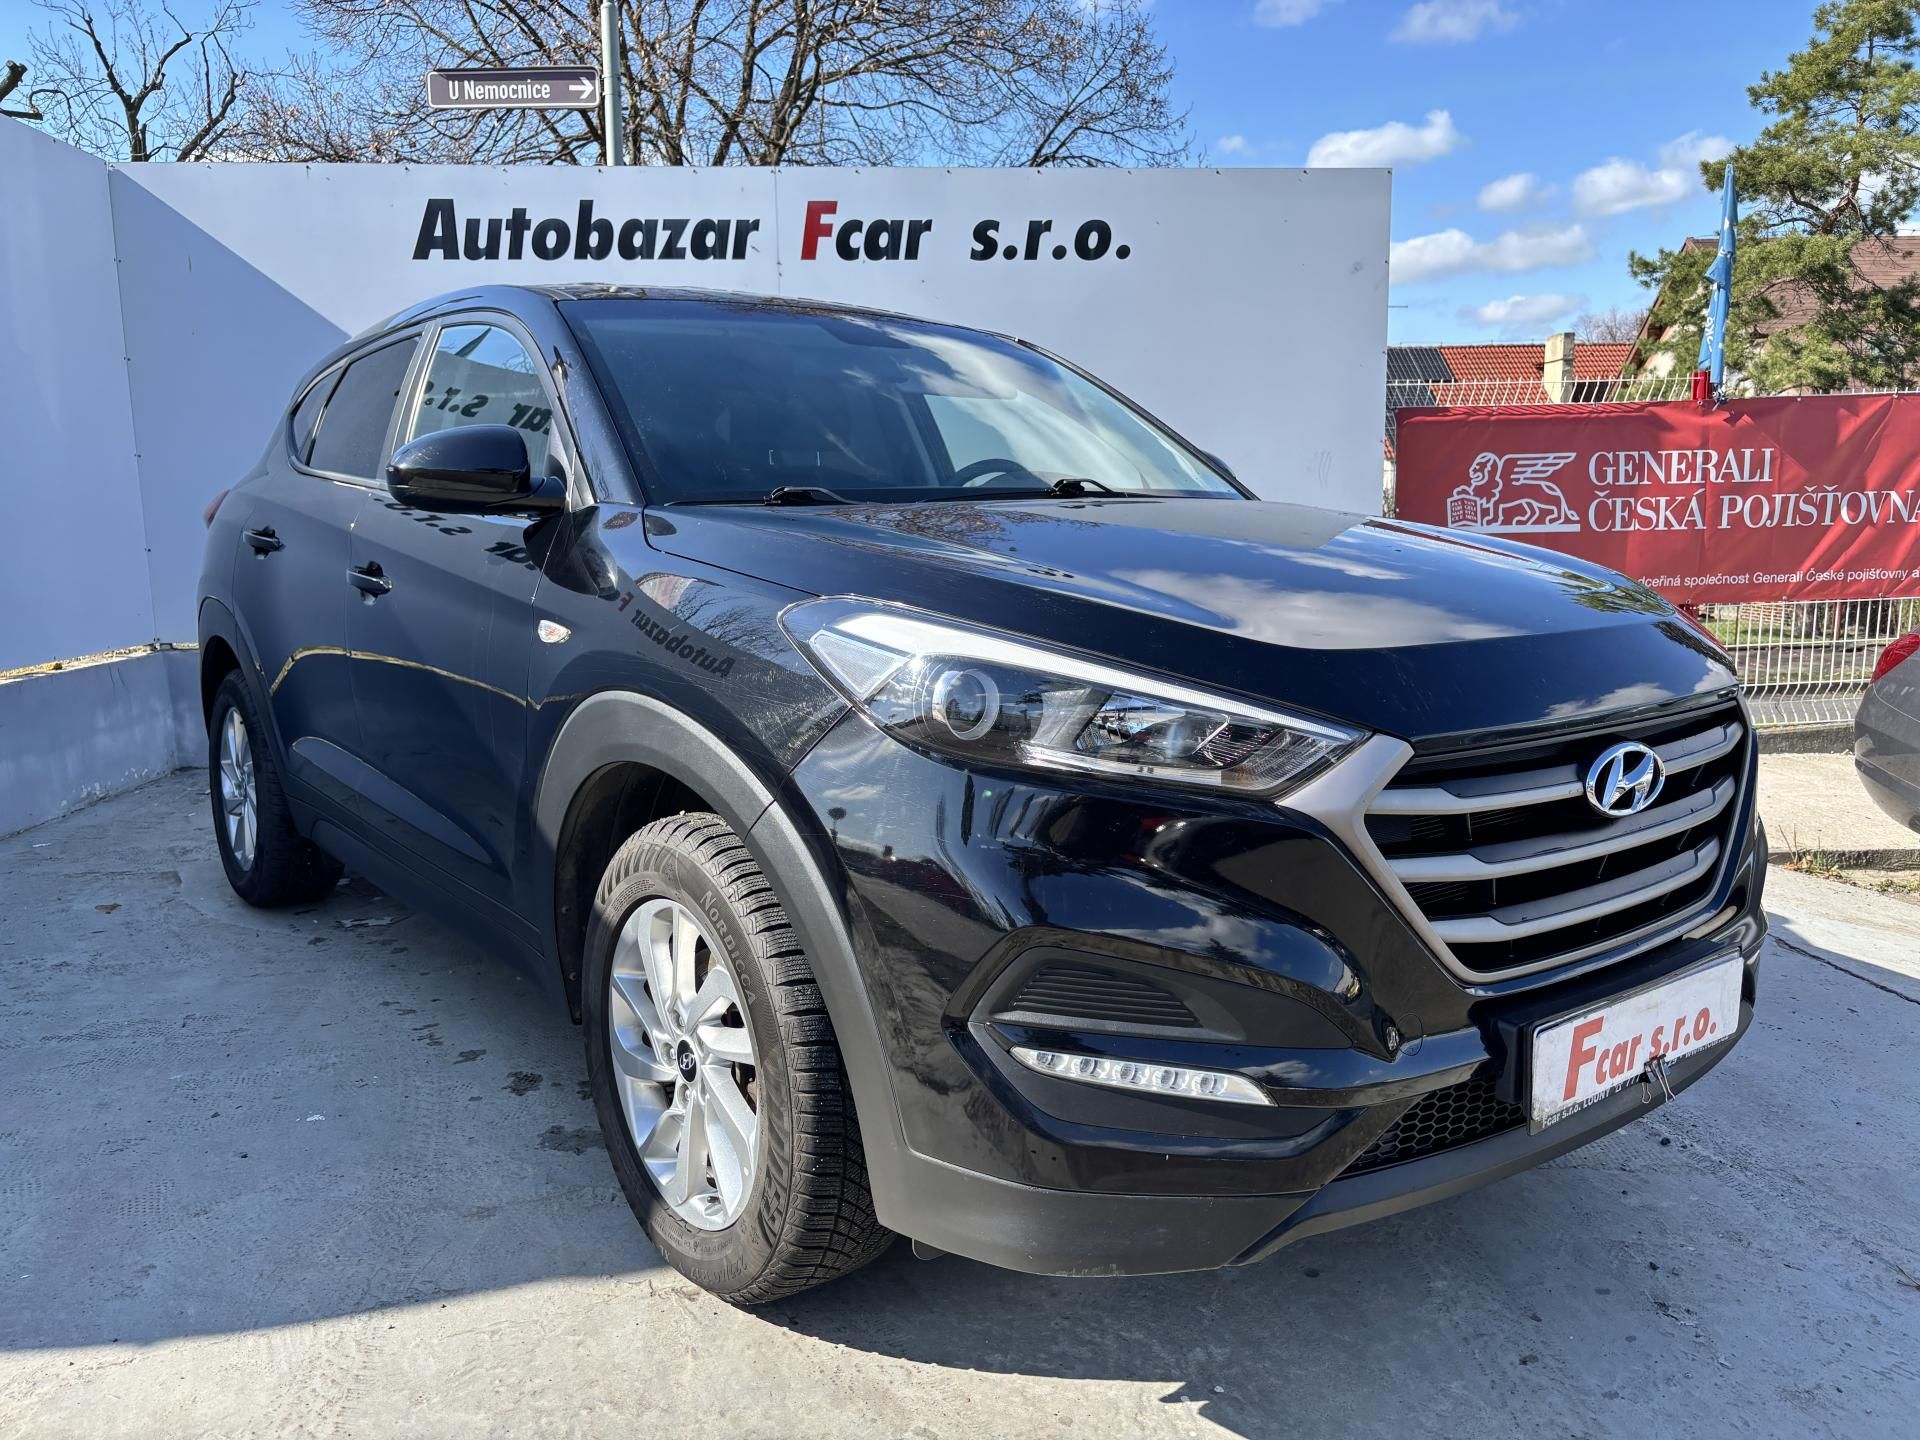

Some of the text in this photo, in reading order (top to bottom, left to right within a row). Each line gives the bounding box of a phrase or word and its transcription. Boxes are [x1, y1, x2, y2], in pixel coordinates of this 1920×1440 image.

[448, 79, 551, 100] U Nemocnice
[412, 198, 1132, 262] Autobazar Fcar s.r.o.
[1588, 447, 1775, 486] GENERALI
[1588, 487, 1706, 533] ČESKÁ
[1683, 572, 1750, 588] společnost
[1753, 569, 1804, 584] Generali
[1805, 567, 1845, 582] České
[1847, 567, 1909, 583] pojišťovny
[1562, 1006, 1717, 1102] Fcar s.r.o.
